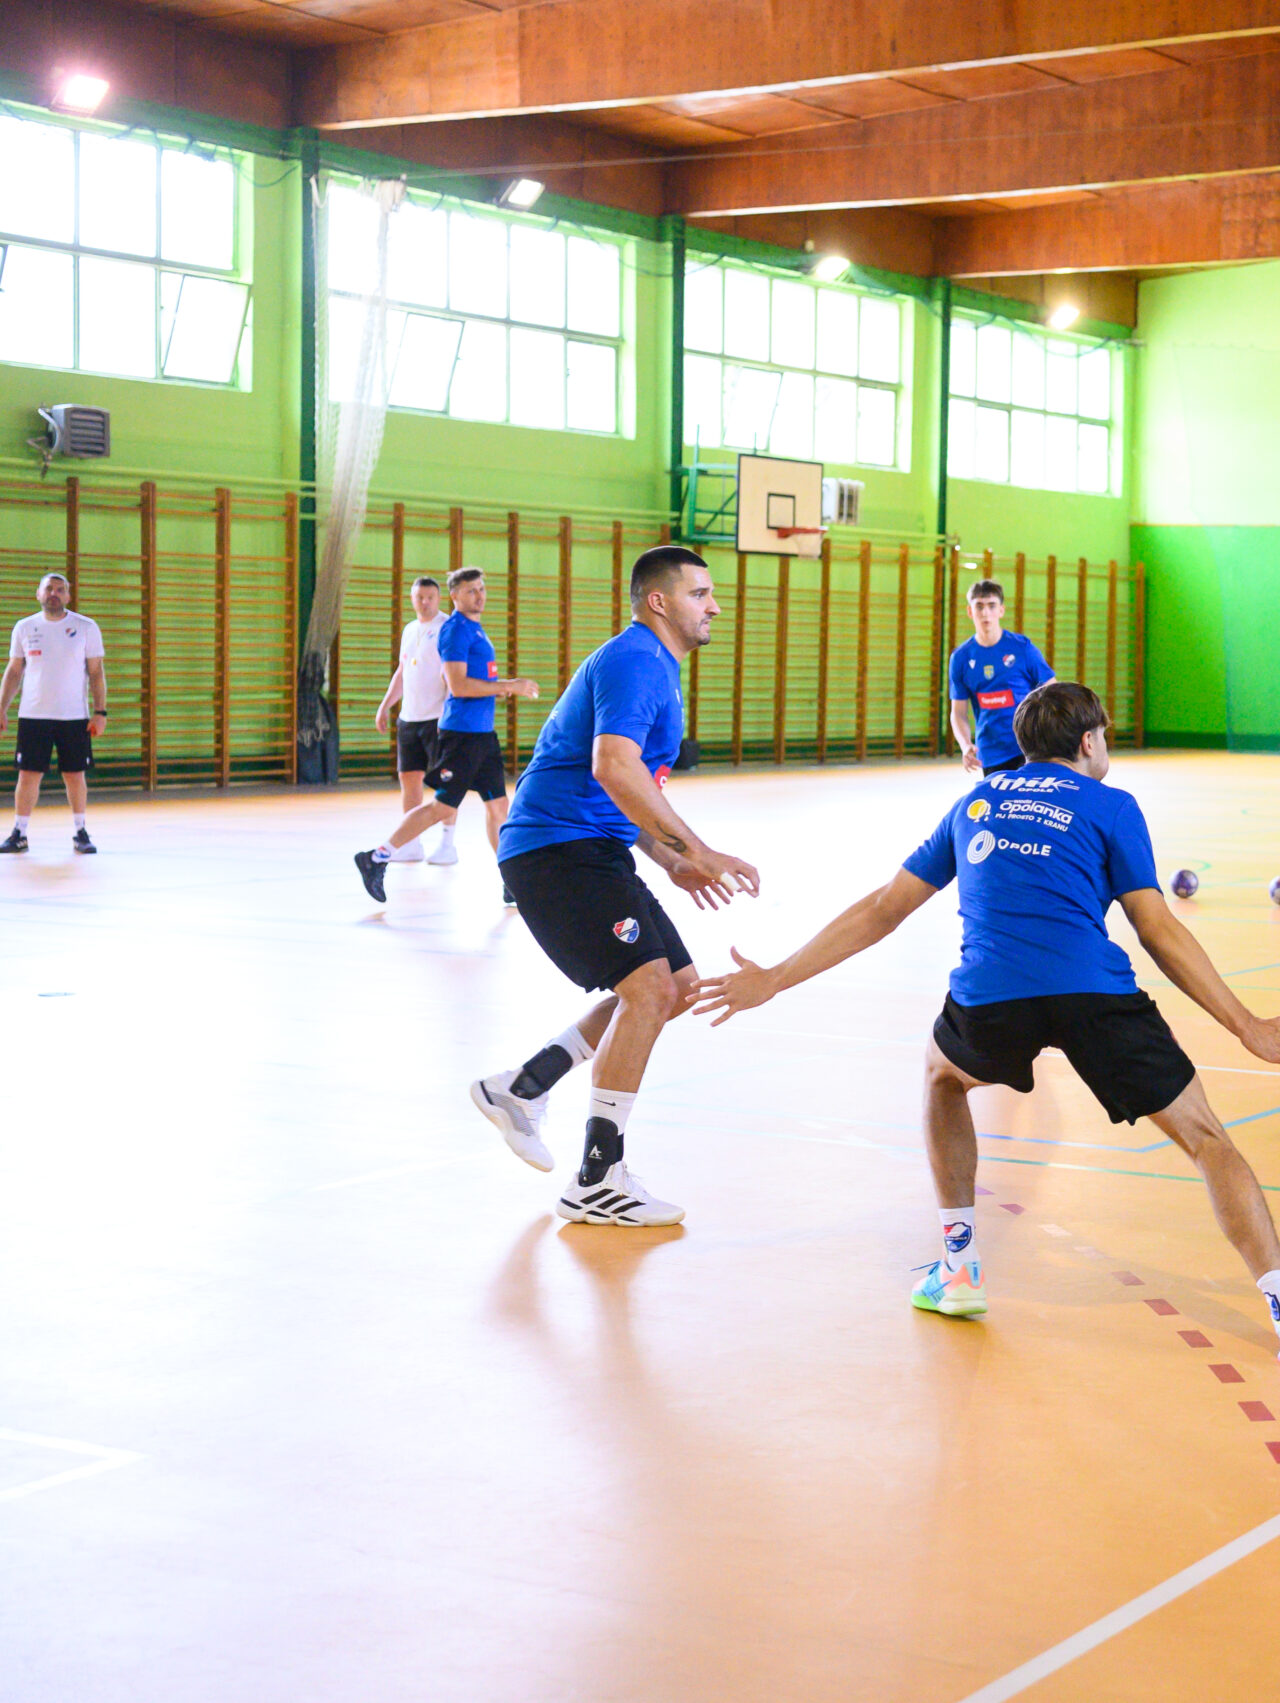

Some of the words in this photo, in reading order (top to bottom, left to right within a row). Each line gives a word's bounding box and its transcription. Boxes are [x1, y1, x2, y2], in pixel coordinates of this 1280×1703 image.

[999, 802, 1073, 825] Opolanka
[1043, 819, 1069, 832] KRANU
[997, 838, 1052, 857] OPOLE
